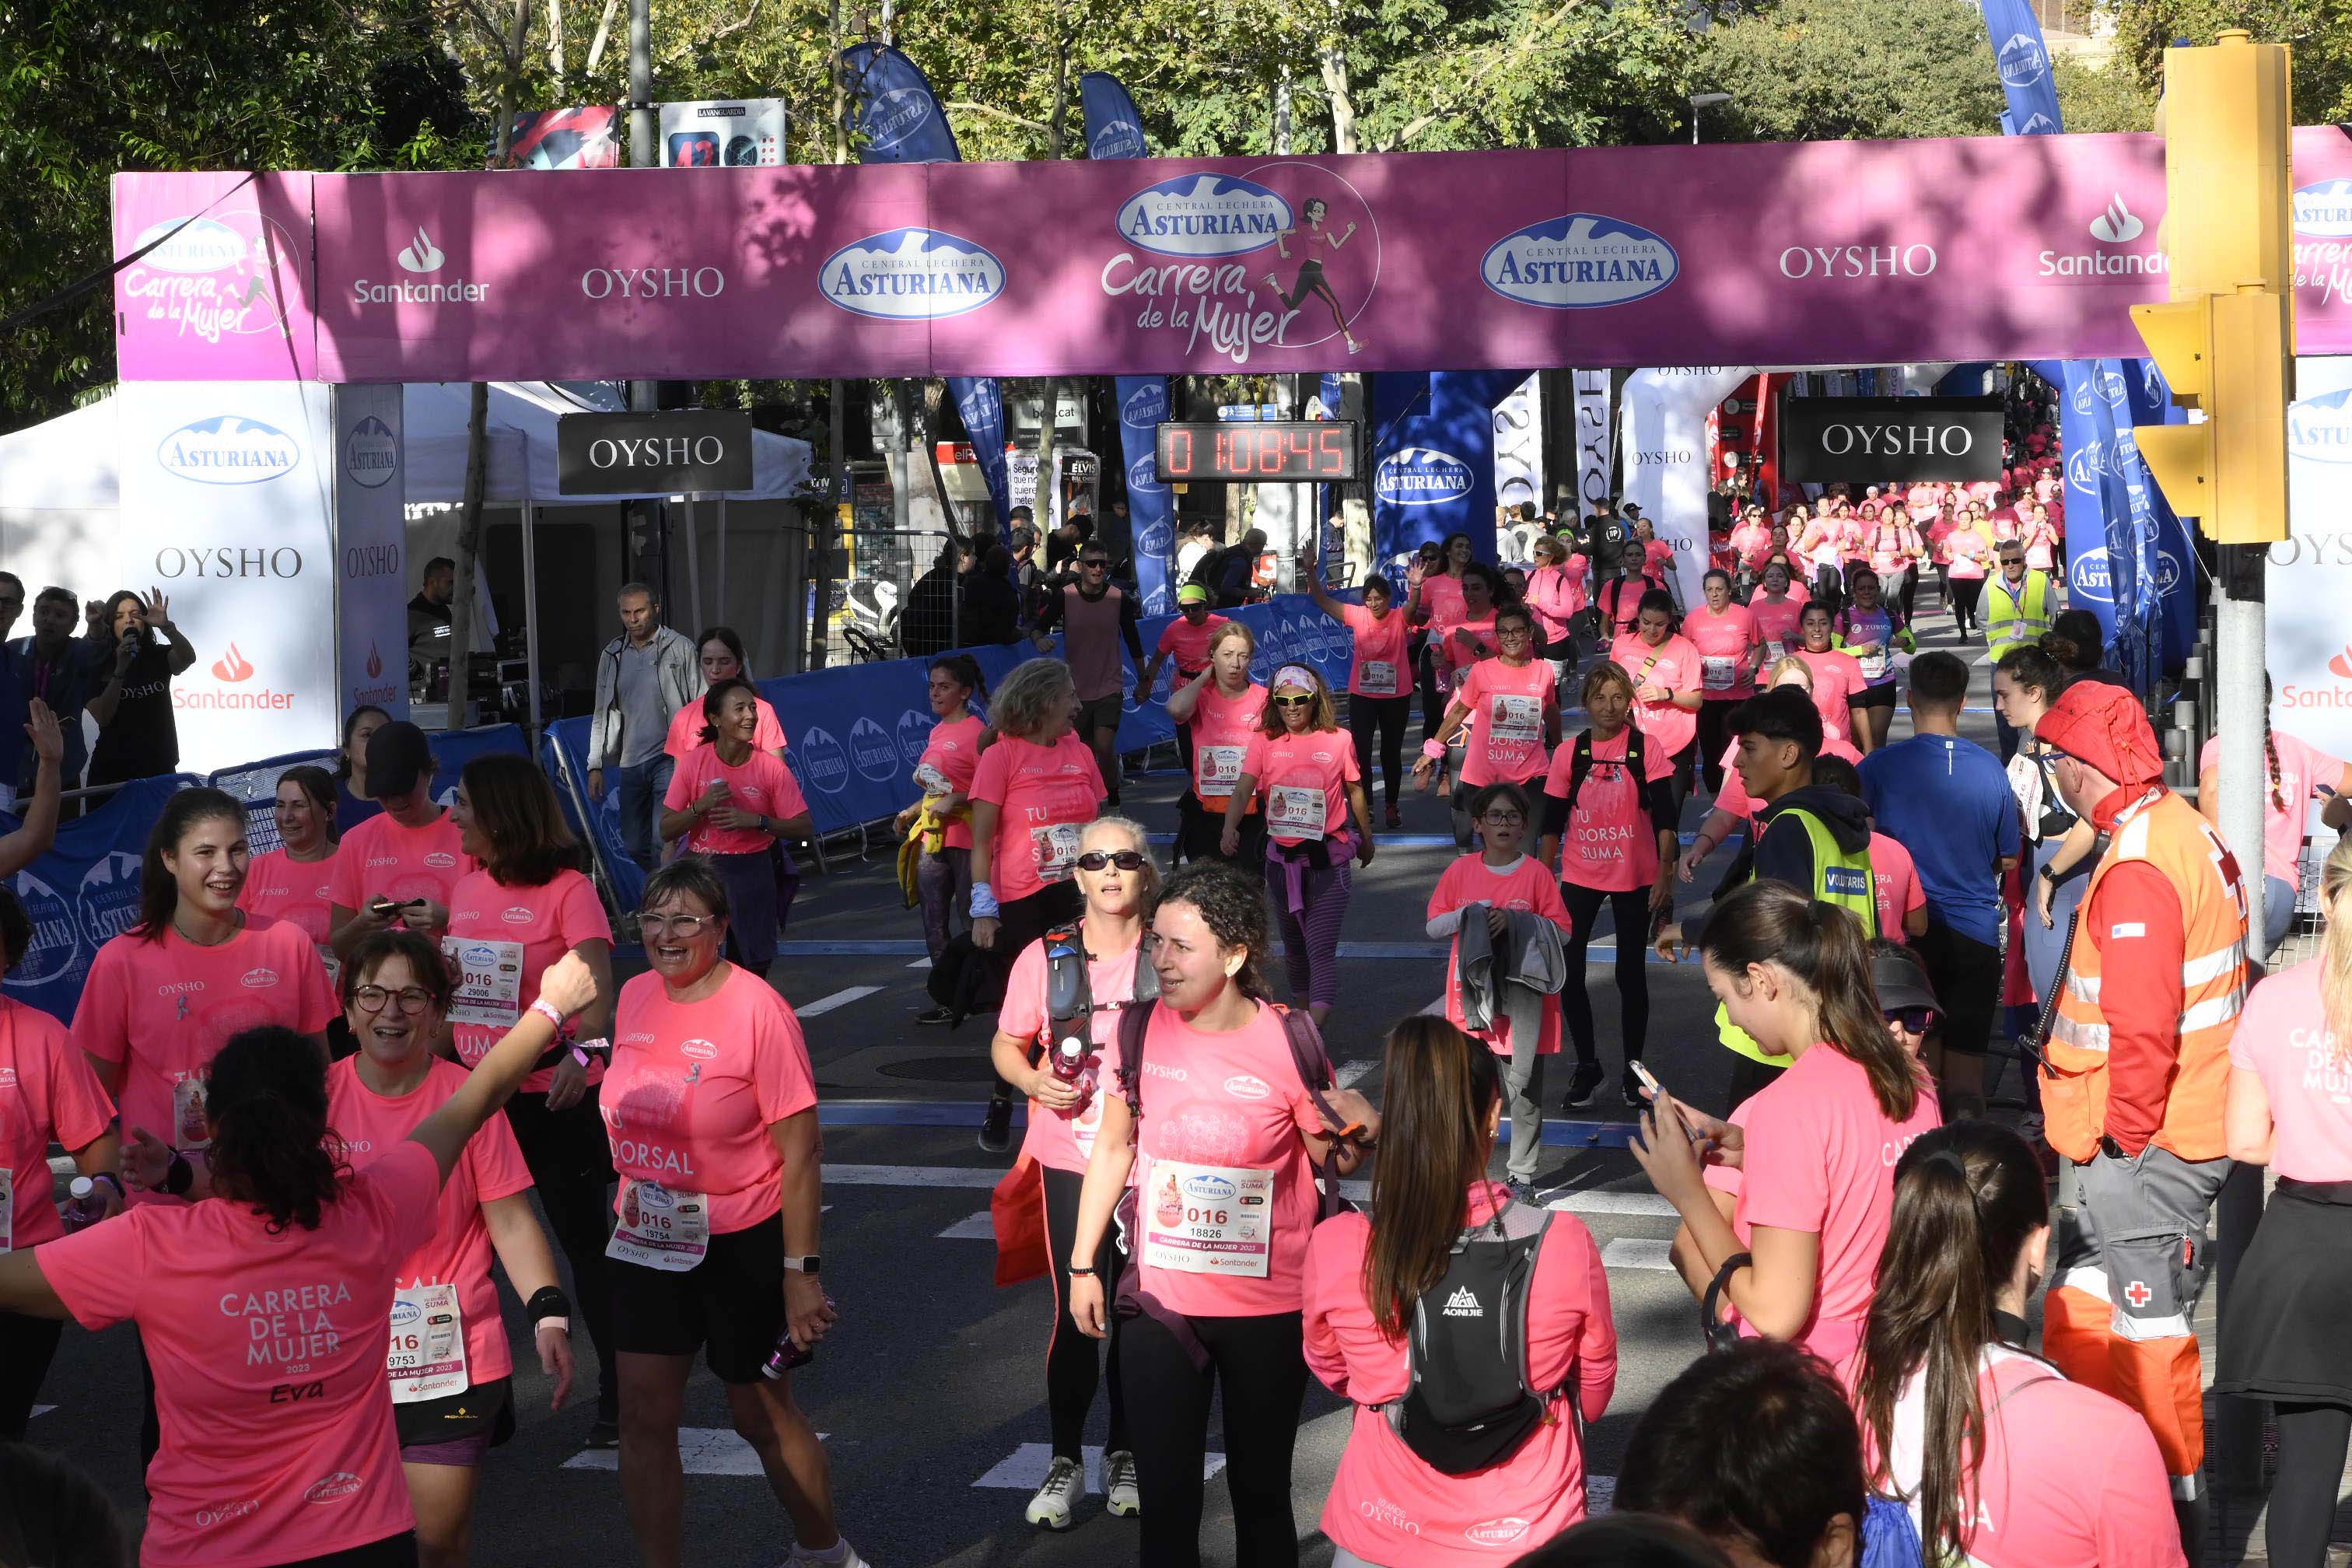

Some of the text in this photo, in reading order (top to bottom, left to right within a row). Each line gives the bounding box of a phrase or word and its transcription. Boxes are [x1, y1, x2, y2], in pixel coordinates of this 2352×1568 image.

[1157, 199, 1274, 211] CENTRAL LECHERA
[1129, 204, 1279, 236] ASTURIANA
[1526, 244, 1657, 257] CENTRAL LECHERA
[861, 257, 985, 269] CENTRAL LECHERA
[1496, 250, 1664, 285] ASTURIANA
[1779, 243, 1937, 279] OYSHO
[581, 266, 725, 299] OYSHO
[832, 261, 992, 297] ASTURIANA
[1101, 252, 1248, 297] Carrera
[124, 268, 219, 299] Carrera
[354, 278, 491, 304] Santander
[147, 292, 253, 344] de la Mujer
[1136, 290, 1301, 364] de la Mujer
[1822, 424, 1973, 457] OYSHO
[168, 441, 289, 467] ASTURIANA
[349, 446, 394, 471] ASTURIANA
[589, 435, 724, 469] OYSHO
[1632, 450, 1692, 465] OYSHO
[1071, 462, 1096, 474] ELVIS
[1379, 470, 1467, 492] ASTURIANA
[155, 547, 303, 579] OYSHO
[347, 544, 399, 579] OYSHO
[173, 688, 295, 710] Santander
[353, 680, 397, 709] Santander
[1508, 712, 1525, 720] 016
[1488, 749, 1525, 761] SUMA
[1218, 765, 1237, 774] 016
[1025, 807, 1048, 822] TU
[1288, 807, 1307, 815] 016
[1575, 810, 1591, 824] TU
[1578, 824, 1636, 842] DORSAL
[1580, 845, 1624, 859] SUMA
[366, 856, 397, 867] OYSHO
[259, 887, 289, 896] OYSHO
[465, 972, 492, 986] 016
[158, 980, 205, 996] OYSHO
[467, 988, 489, 997] 29006
[1143, 1061, 1188, 1083] OYSHO
[1228, 1082, 1270, 1096] ASTURIANA
[610, 1139, 694, 1175] DORSAL
[1187, 1181, 1232, 1196] ASTURIANA
[641, 1211, 672, 1230] 016
[1187, 1208, 1228, 1225] 016
[645, 1229, 670, 1241] 19754
[1190, 1227, 1222, 1239] 18826
[1159, 1237, 1190, 1248] CARRERA
[618, 1244, 649, 1260] OYSHO
[1220, 1258, 1258, 1268] Santander
[219, 1280, 352, 1318] CARRERA
[425, 1300, 450, 1309] SUMA
[1442, 1307, 1483, 1318] AONIJIE
[250, 1309, 334, 1341] DE LA
[247, 1332, 341, 1367] MUJER
[285, 1363, 310, 1374] 2023
[409, 1367, 434, 1377] MUJER
[269, 1380, 324, 1404] Eva
[418, 1379, 457, 1391] Santander
